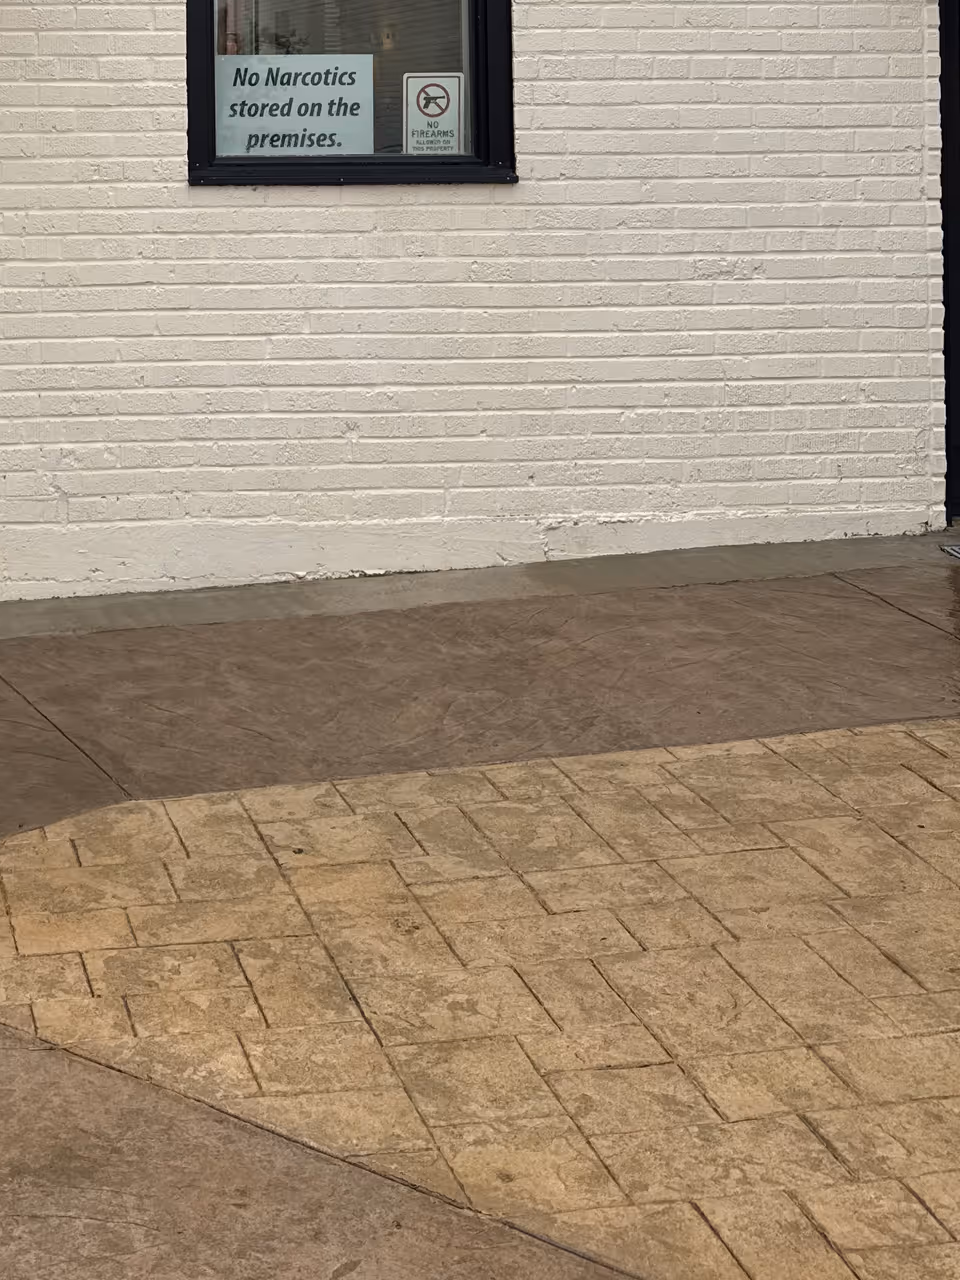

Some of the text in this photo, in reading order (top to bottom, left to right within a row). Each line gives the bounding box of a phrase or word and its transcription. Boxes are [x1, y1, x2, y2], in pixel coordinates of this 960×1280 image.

[232, 66, 357, 87] No Narcotics
[228, 96, 361, 118] stored on the
[411, 130, 455, 138] FIREARMS
[427, 120, 439, 129] NO
[245, 128, 343, 154] premises.
